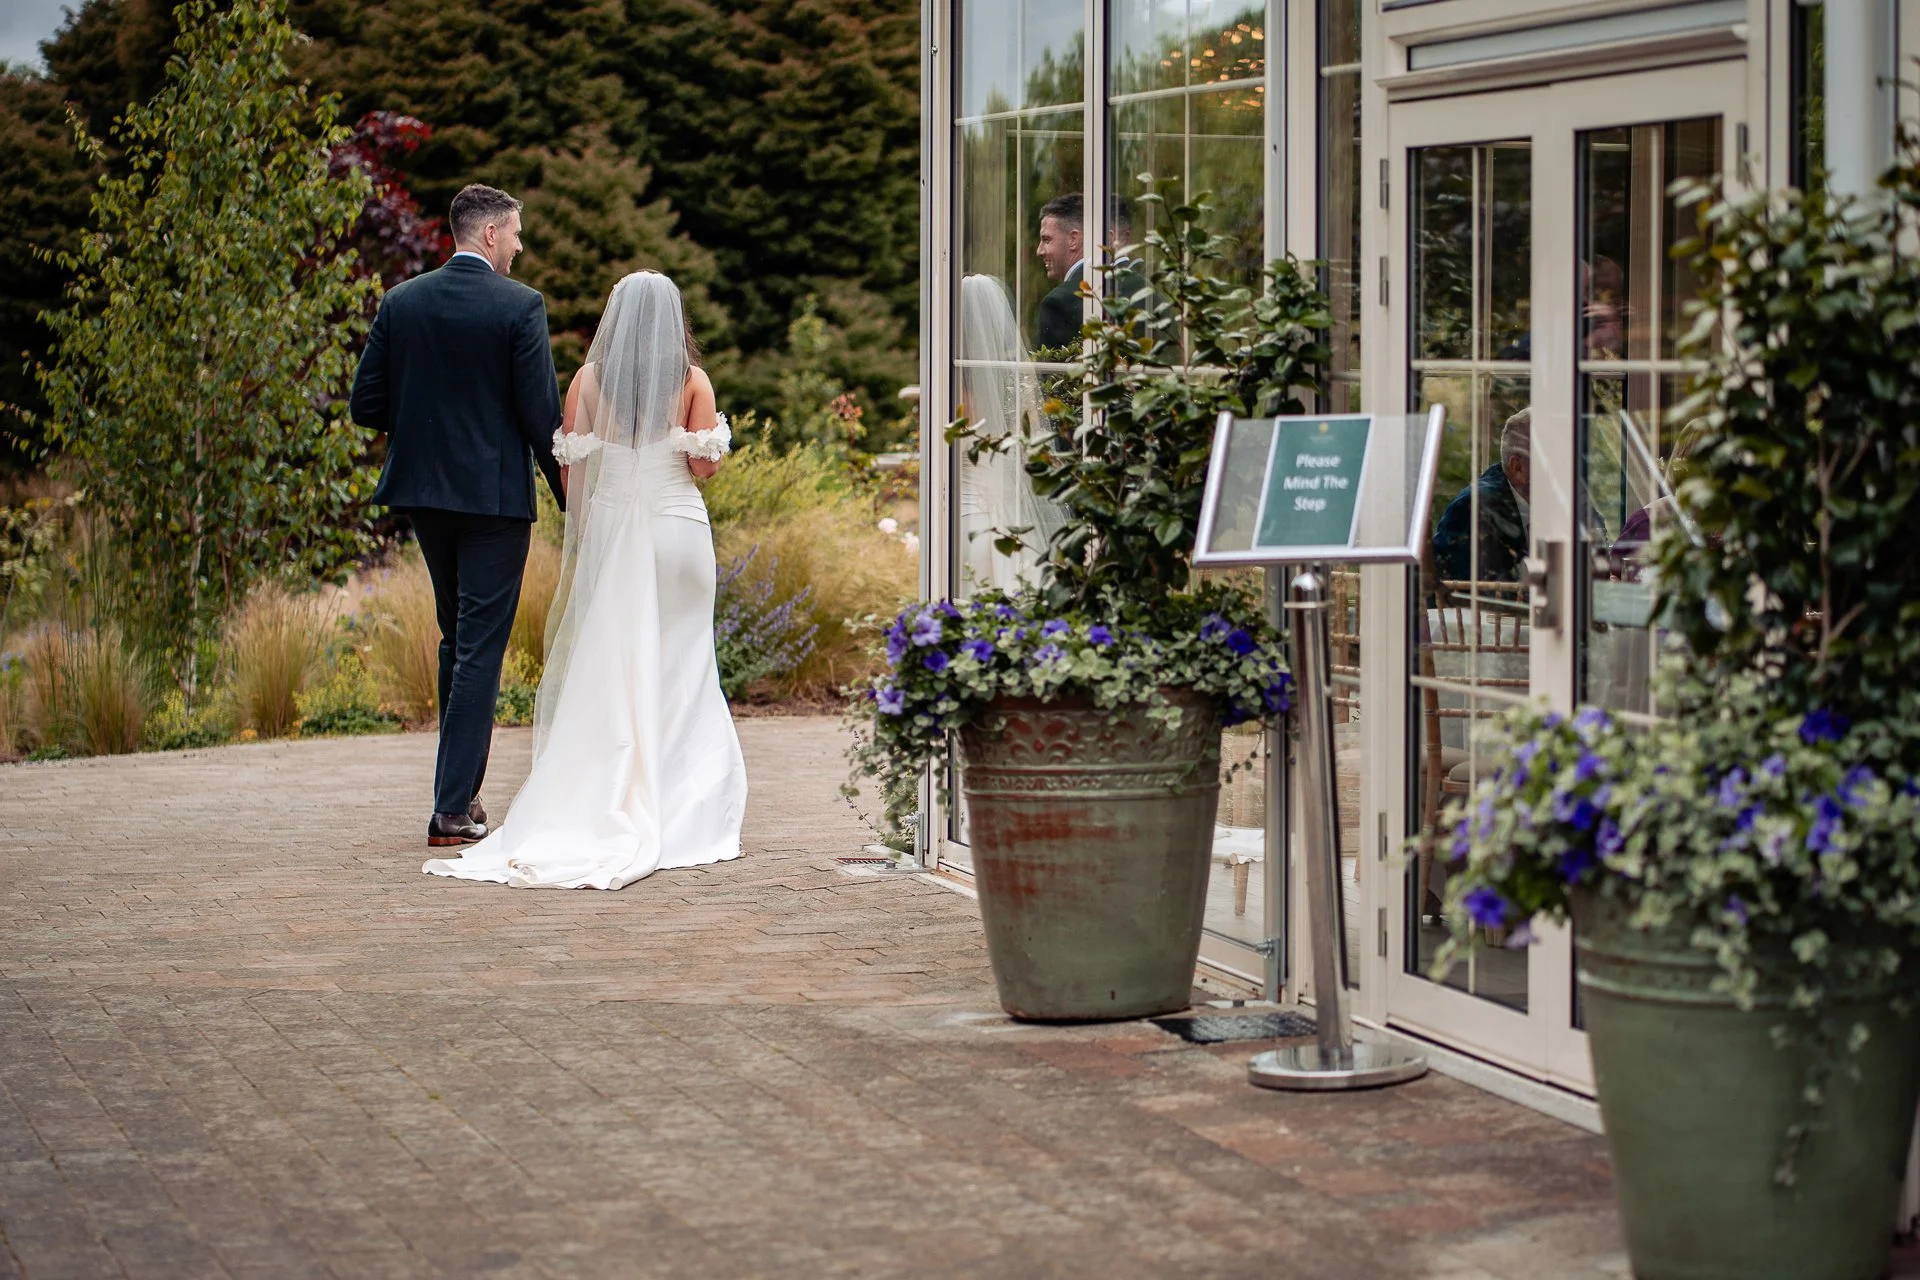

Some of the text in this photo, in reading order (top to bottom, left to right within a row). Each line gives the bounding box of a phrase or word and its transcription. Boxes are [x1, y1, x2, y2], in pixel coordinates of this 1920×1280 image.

[1296, 453, 1341, 468] Please
[1283, 475, 1349, 491] Mind The
[1293, 497, 1327, 513] Step
